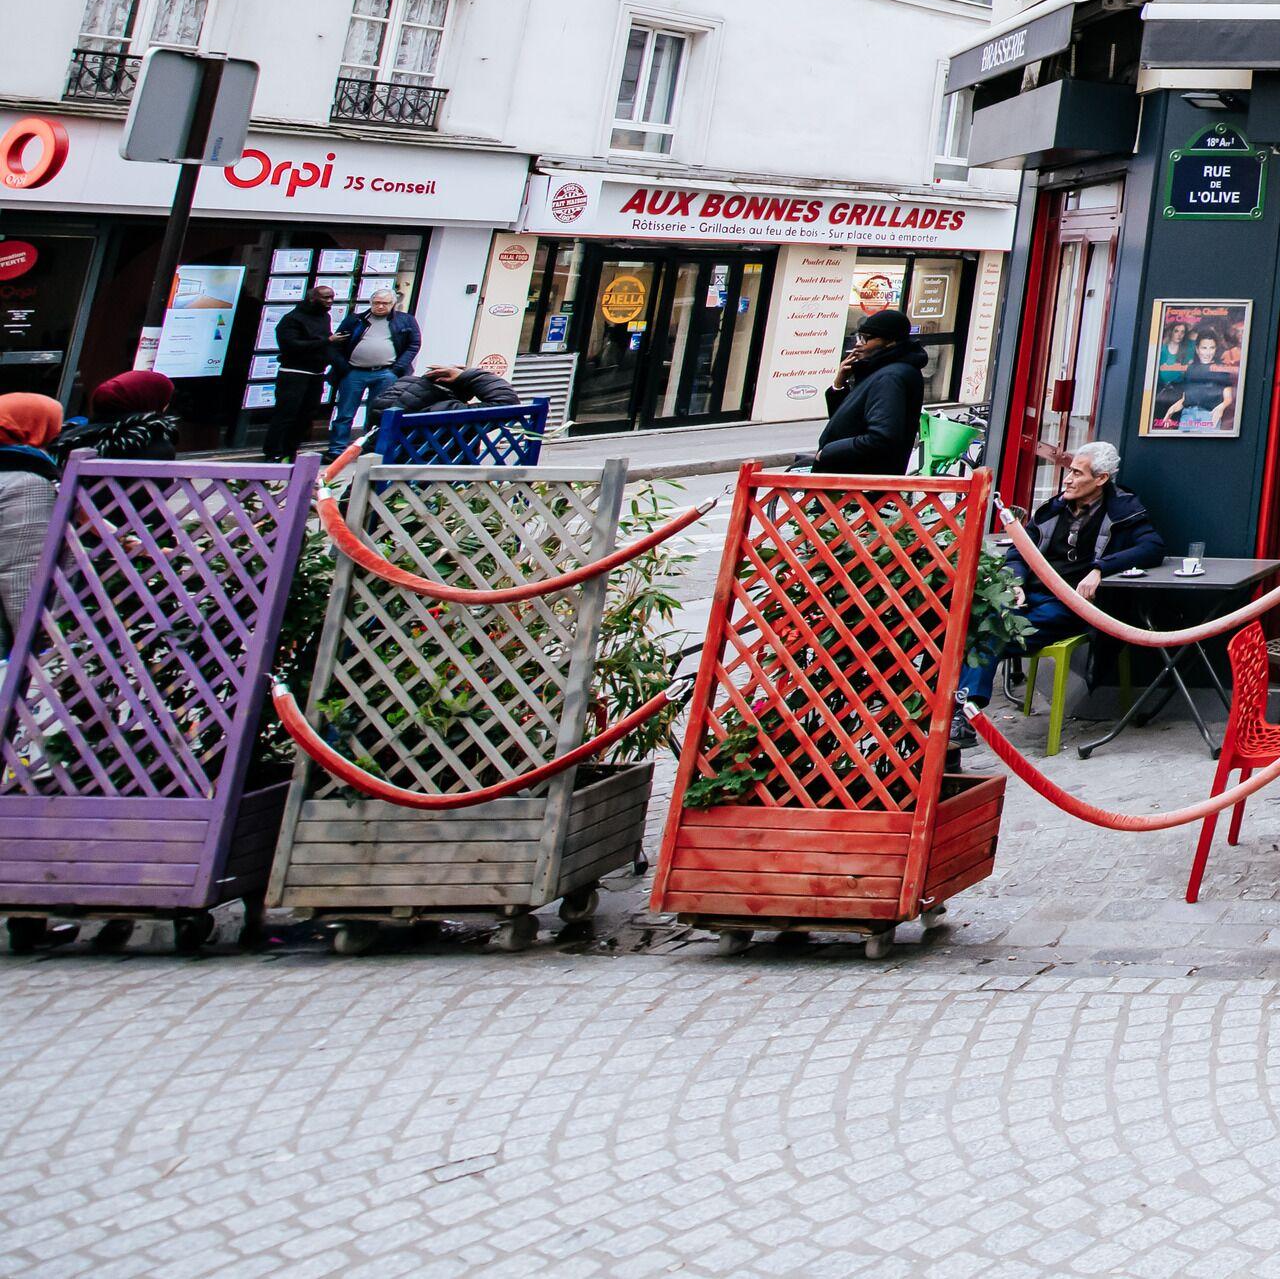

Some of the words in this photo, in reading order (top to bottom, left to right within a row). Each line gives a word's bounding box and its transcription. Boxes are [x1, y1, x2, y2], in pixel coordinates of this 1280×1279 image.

[980, 29, 1028, 72] BRASSERIE
[223, 148, 336, 198] Orpi
[344, 176, 364, 190] JS
[371, 178, 436, 195] Conseil
[1203, 166, 1231, 177] RUE
[1189, 191, 1240, 203] L'OLIVE
[620, 189, 698, 216] AUX
[699, 194, 823, 223] BONNES
[828, 202, 966, 231] GRILLADES
[632, 219, 686, 232] Rôtisserie
[700, 222, 746, 235] Grillades
[750, 227, 762, 235] au
[766, 225, 781, 236] feu
[785, 226, 797, 236] de
[800, 227, 818, 237] bois
[829, 228, 844, 239] Sur
[847, 230, 872, 241] place
[898, 234, 938, 244] emporter
[601, 294, 645, 305] PAELLA
